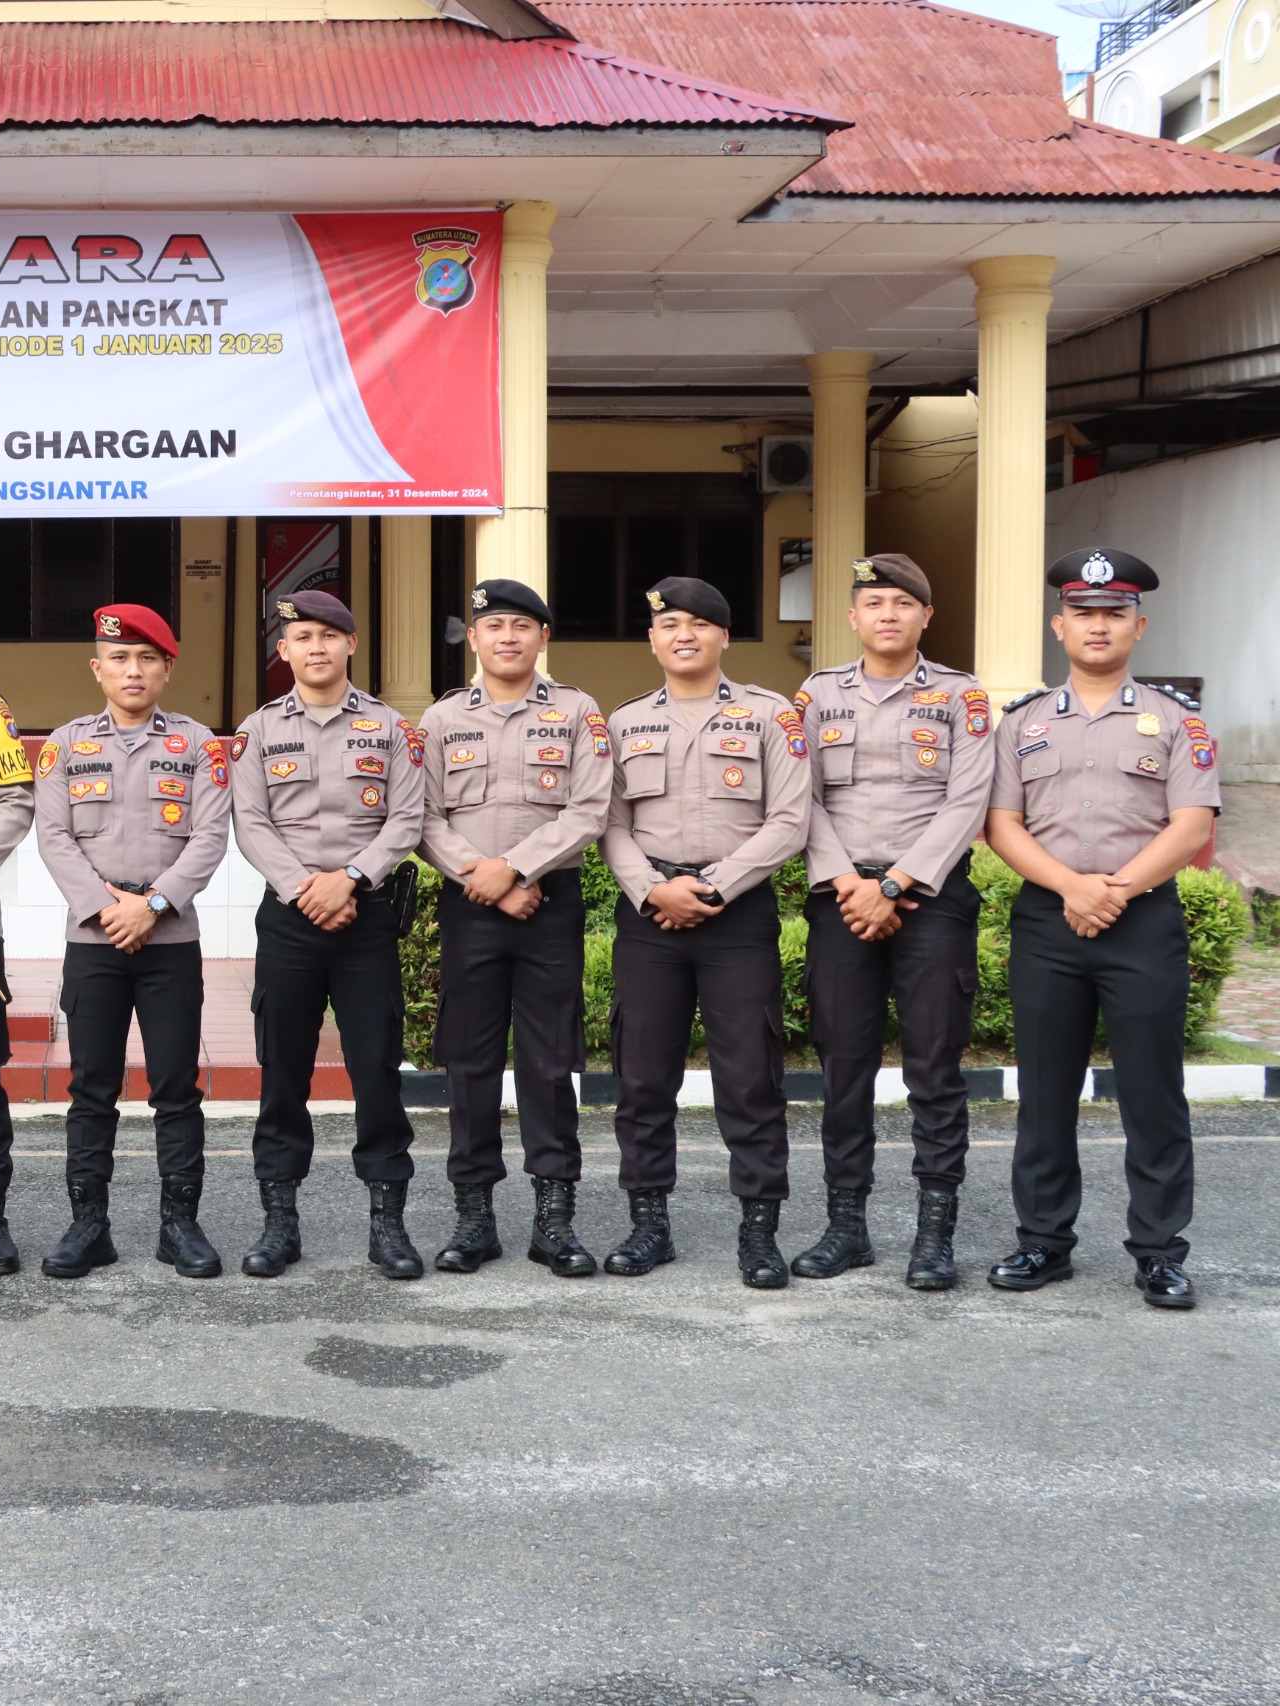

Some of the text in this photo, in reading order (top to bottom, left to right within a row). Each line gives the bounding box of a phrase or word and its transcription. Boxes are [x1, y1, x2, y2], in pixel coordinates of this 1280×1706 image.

[62, 298, 228, 328] PANGKAT
[70, 336, 84, 357] 1
[94, 335, 211, 356] JANUARI
[219, 333, 283, 355] 2025
[289, 489, 488, 499] Pematangsiantar, 31 Desember 2024
[906, 708, 951, 723] POLRI
[526, 727, 571, 738] POLRI
[710, 721, 761, 732] POLRI
[346, 738, 390, 750] POLRI
[149, 760, 195, 775] POLRI
